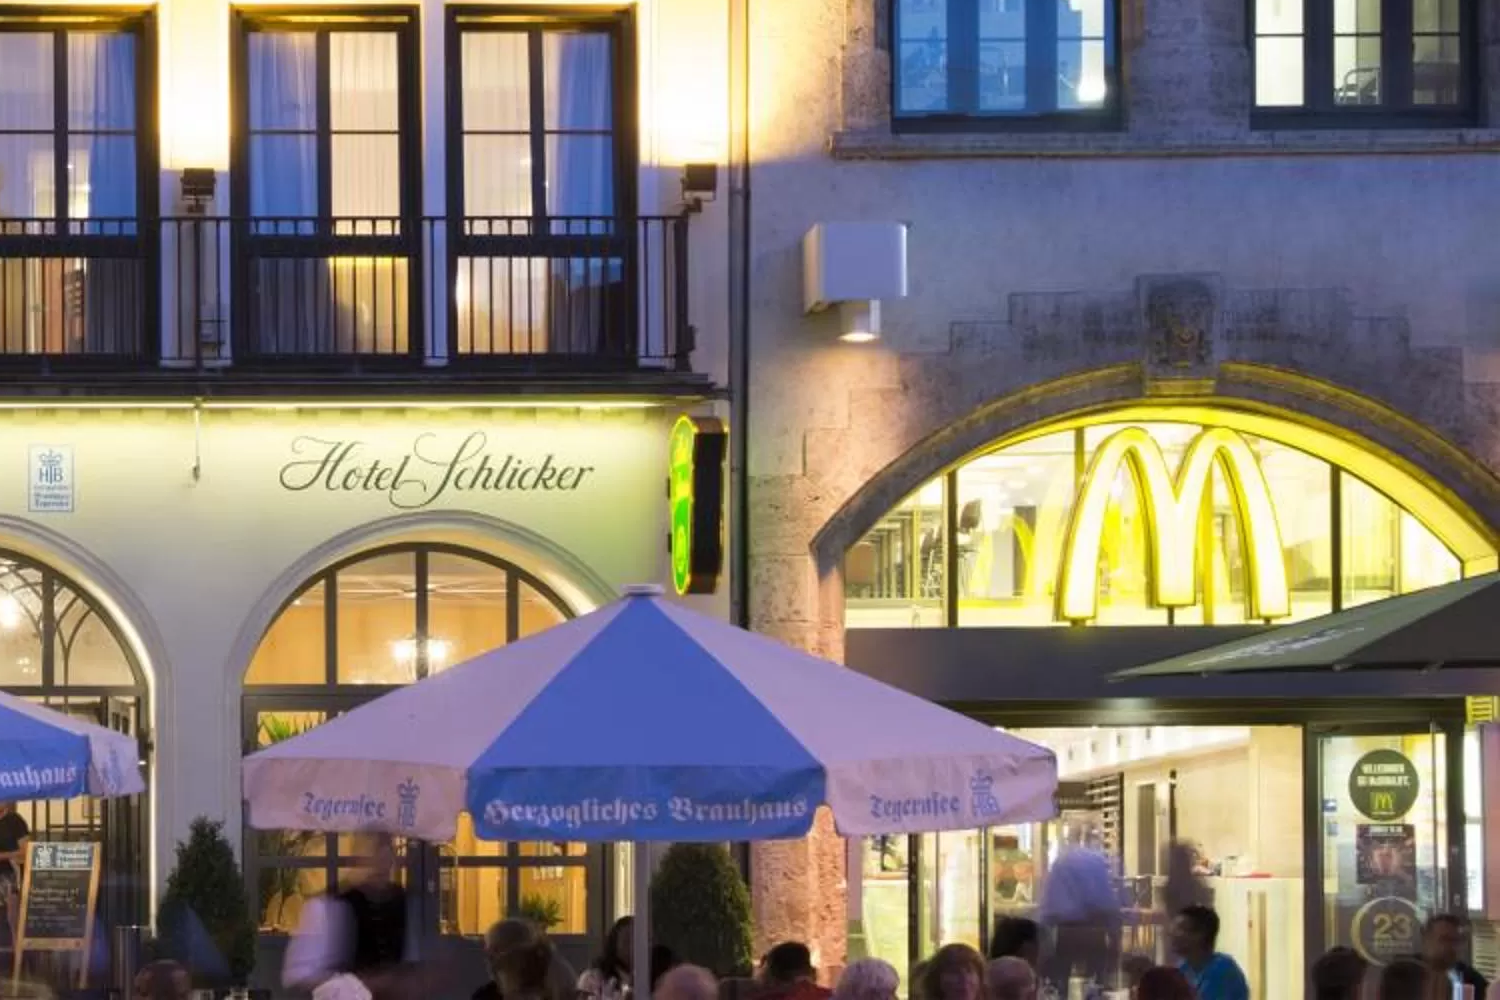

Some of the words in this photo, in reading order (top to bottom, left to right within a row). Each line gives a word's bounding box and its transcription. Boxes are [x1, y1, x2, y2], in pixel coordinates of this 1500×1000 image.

[279, 436, 427, 491] Hotel
[389, 431, 594, 509] Schlicker
[484, 799, 657, 828] Herzogliches
[668, 795, 807, 824] Brauhaus
[870, 793, 960, 822] Tegernsee
[1373, 912, 1413, 940] 23
